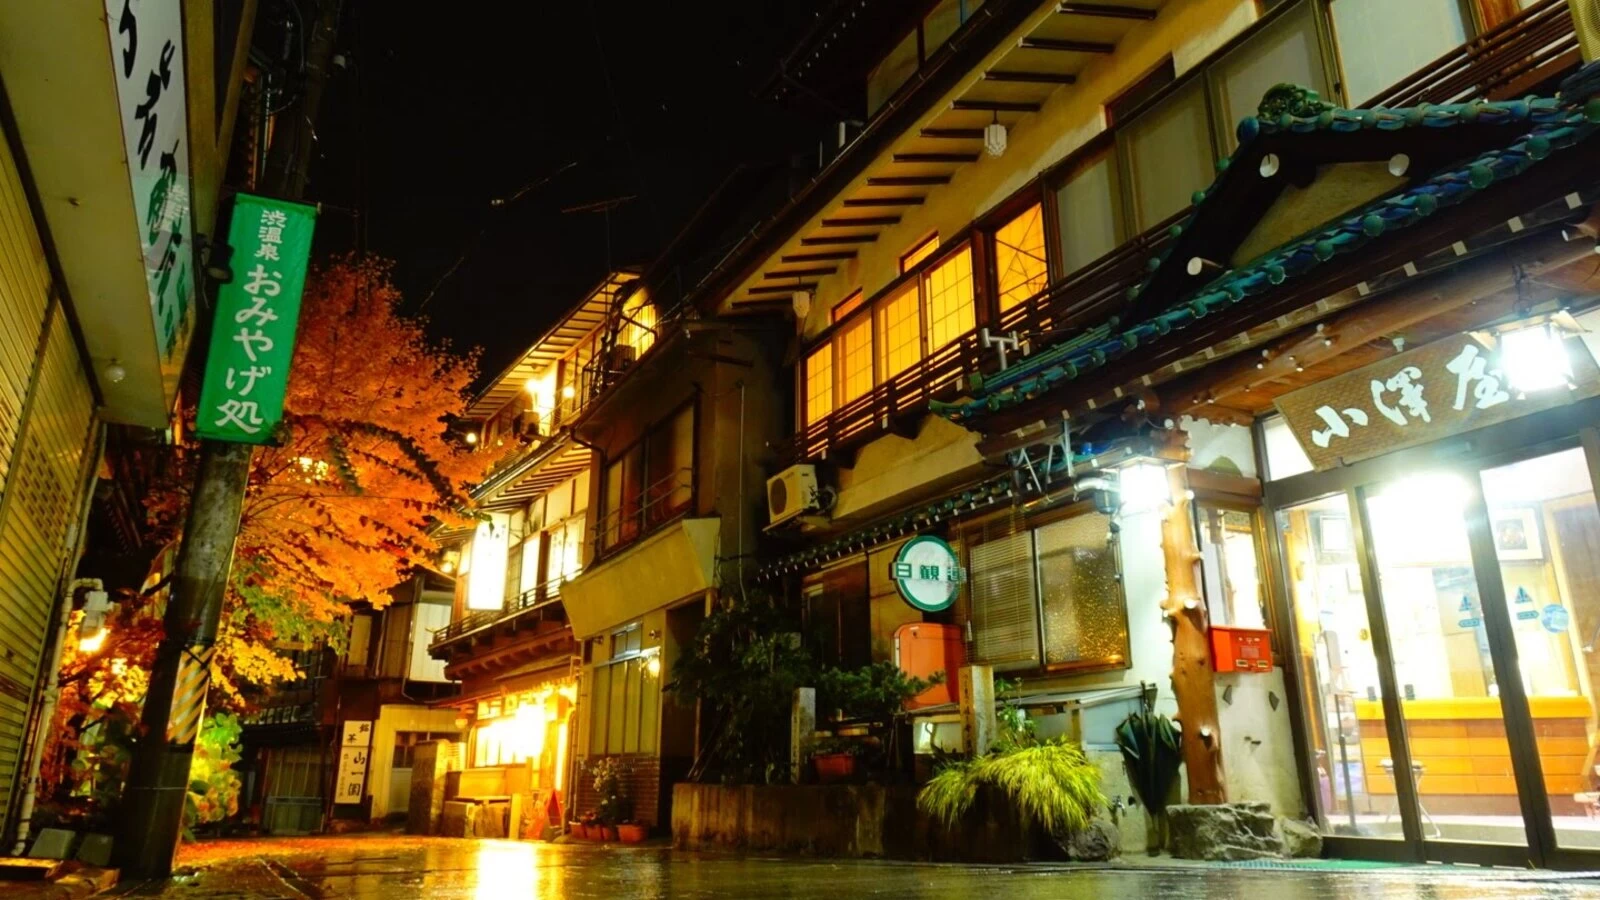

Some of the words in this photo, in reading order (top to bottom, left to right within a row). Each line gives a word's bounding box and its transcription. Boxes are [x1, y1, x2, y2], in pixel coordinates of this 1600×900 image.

[254, 210, 287, 261] 渋温泉
[215, 264, 283, 434] おみやげ処
[1312, 344, 1510, 447] 小澤屋
